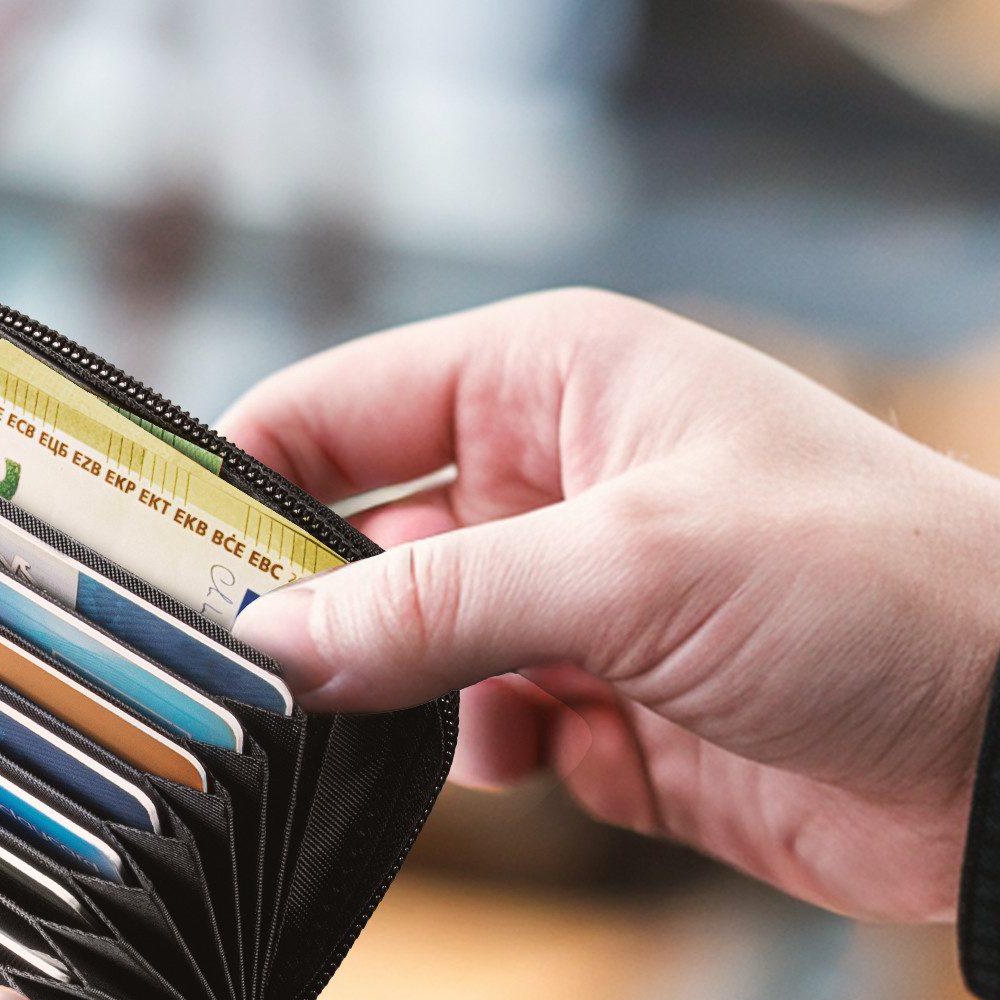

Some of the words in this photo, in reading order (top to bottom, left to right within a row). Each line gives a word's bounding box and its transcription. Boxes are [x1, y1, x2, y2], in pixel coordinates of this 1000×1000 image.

[7, 413, 36, 438] ECB
[71, 450, 102, 477] EZB
[104, 469, 136, 494] EKP
[173, 508, 208, 536] EKB
[248, 550, 284, 580] EBC
